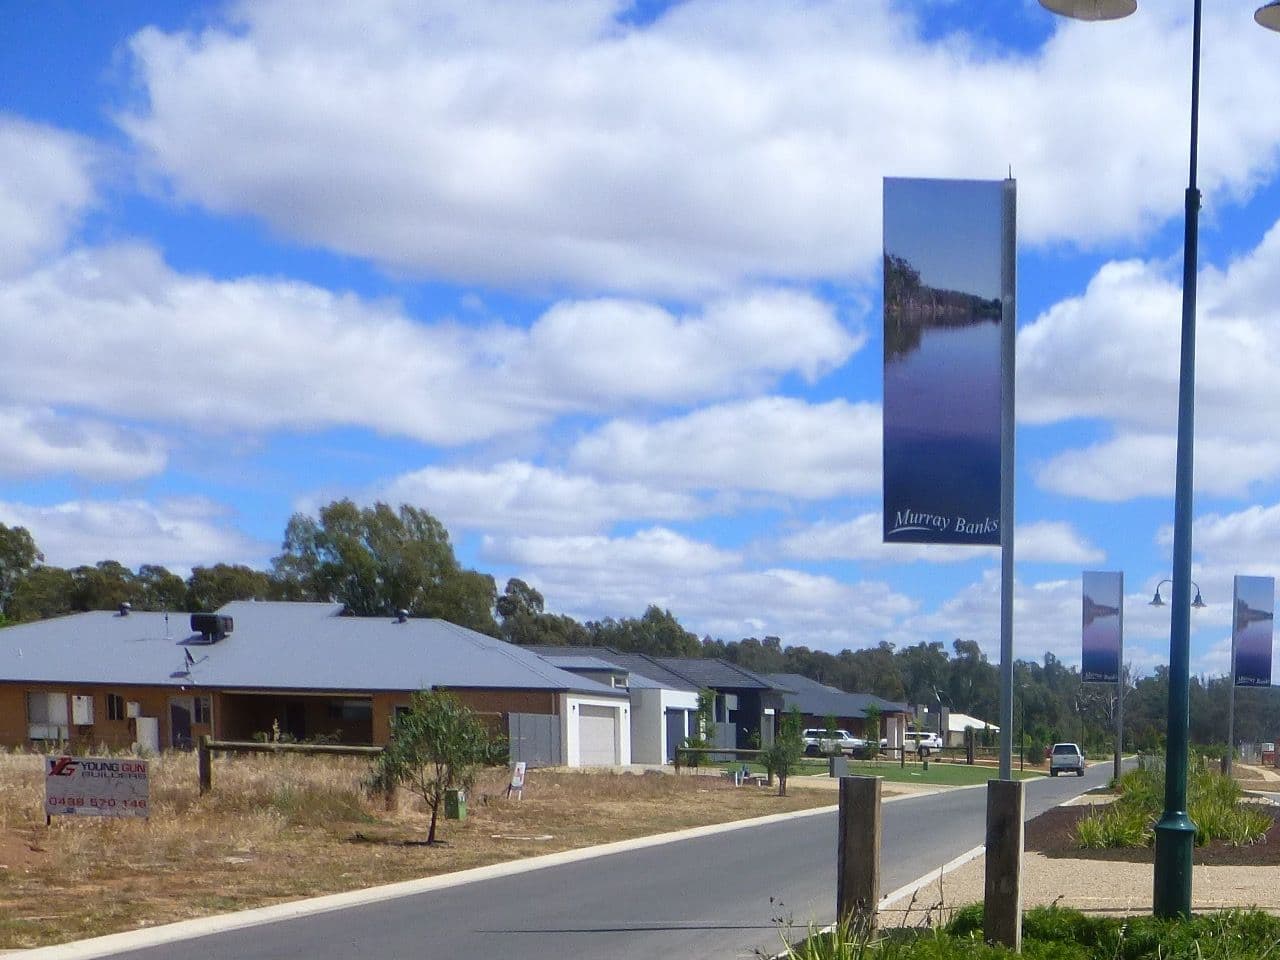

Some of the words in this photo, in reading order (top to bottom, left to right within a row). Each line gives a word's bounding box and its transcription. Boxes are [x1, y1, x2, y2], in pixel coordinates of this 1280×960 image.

[895, 508, 950, 531] Murray
[955, 517, 999, 534] Banks
[82, 761, 119, 772] YOUNG
[121, 763, 146, 773] GUN
